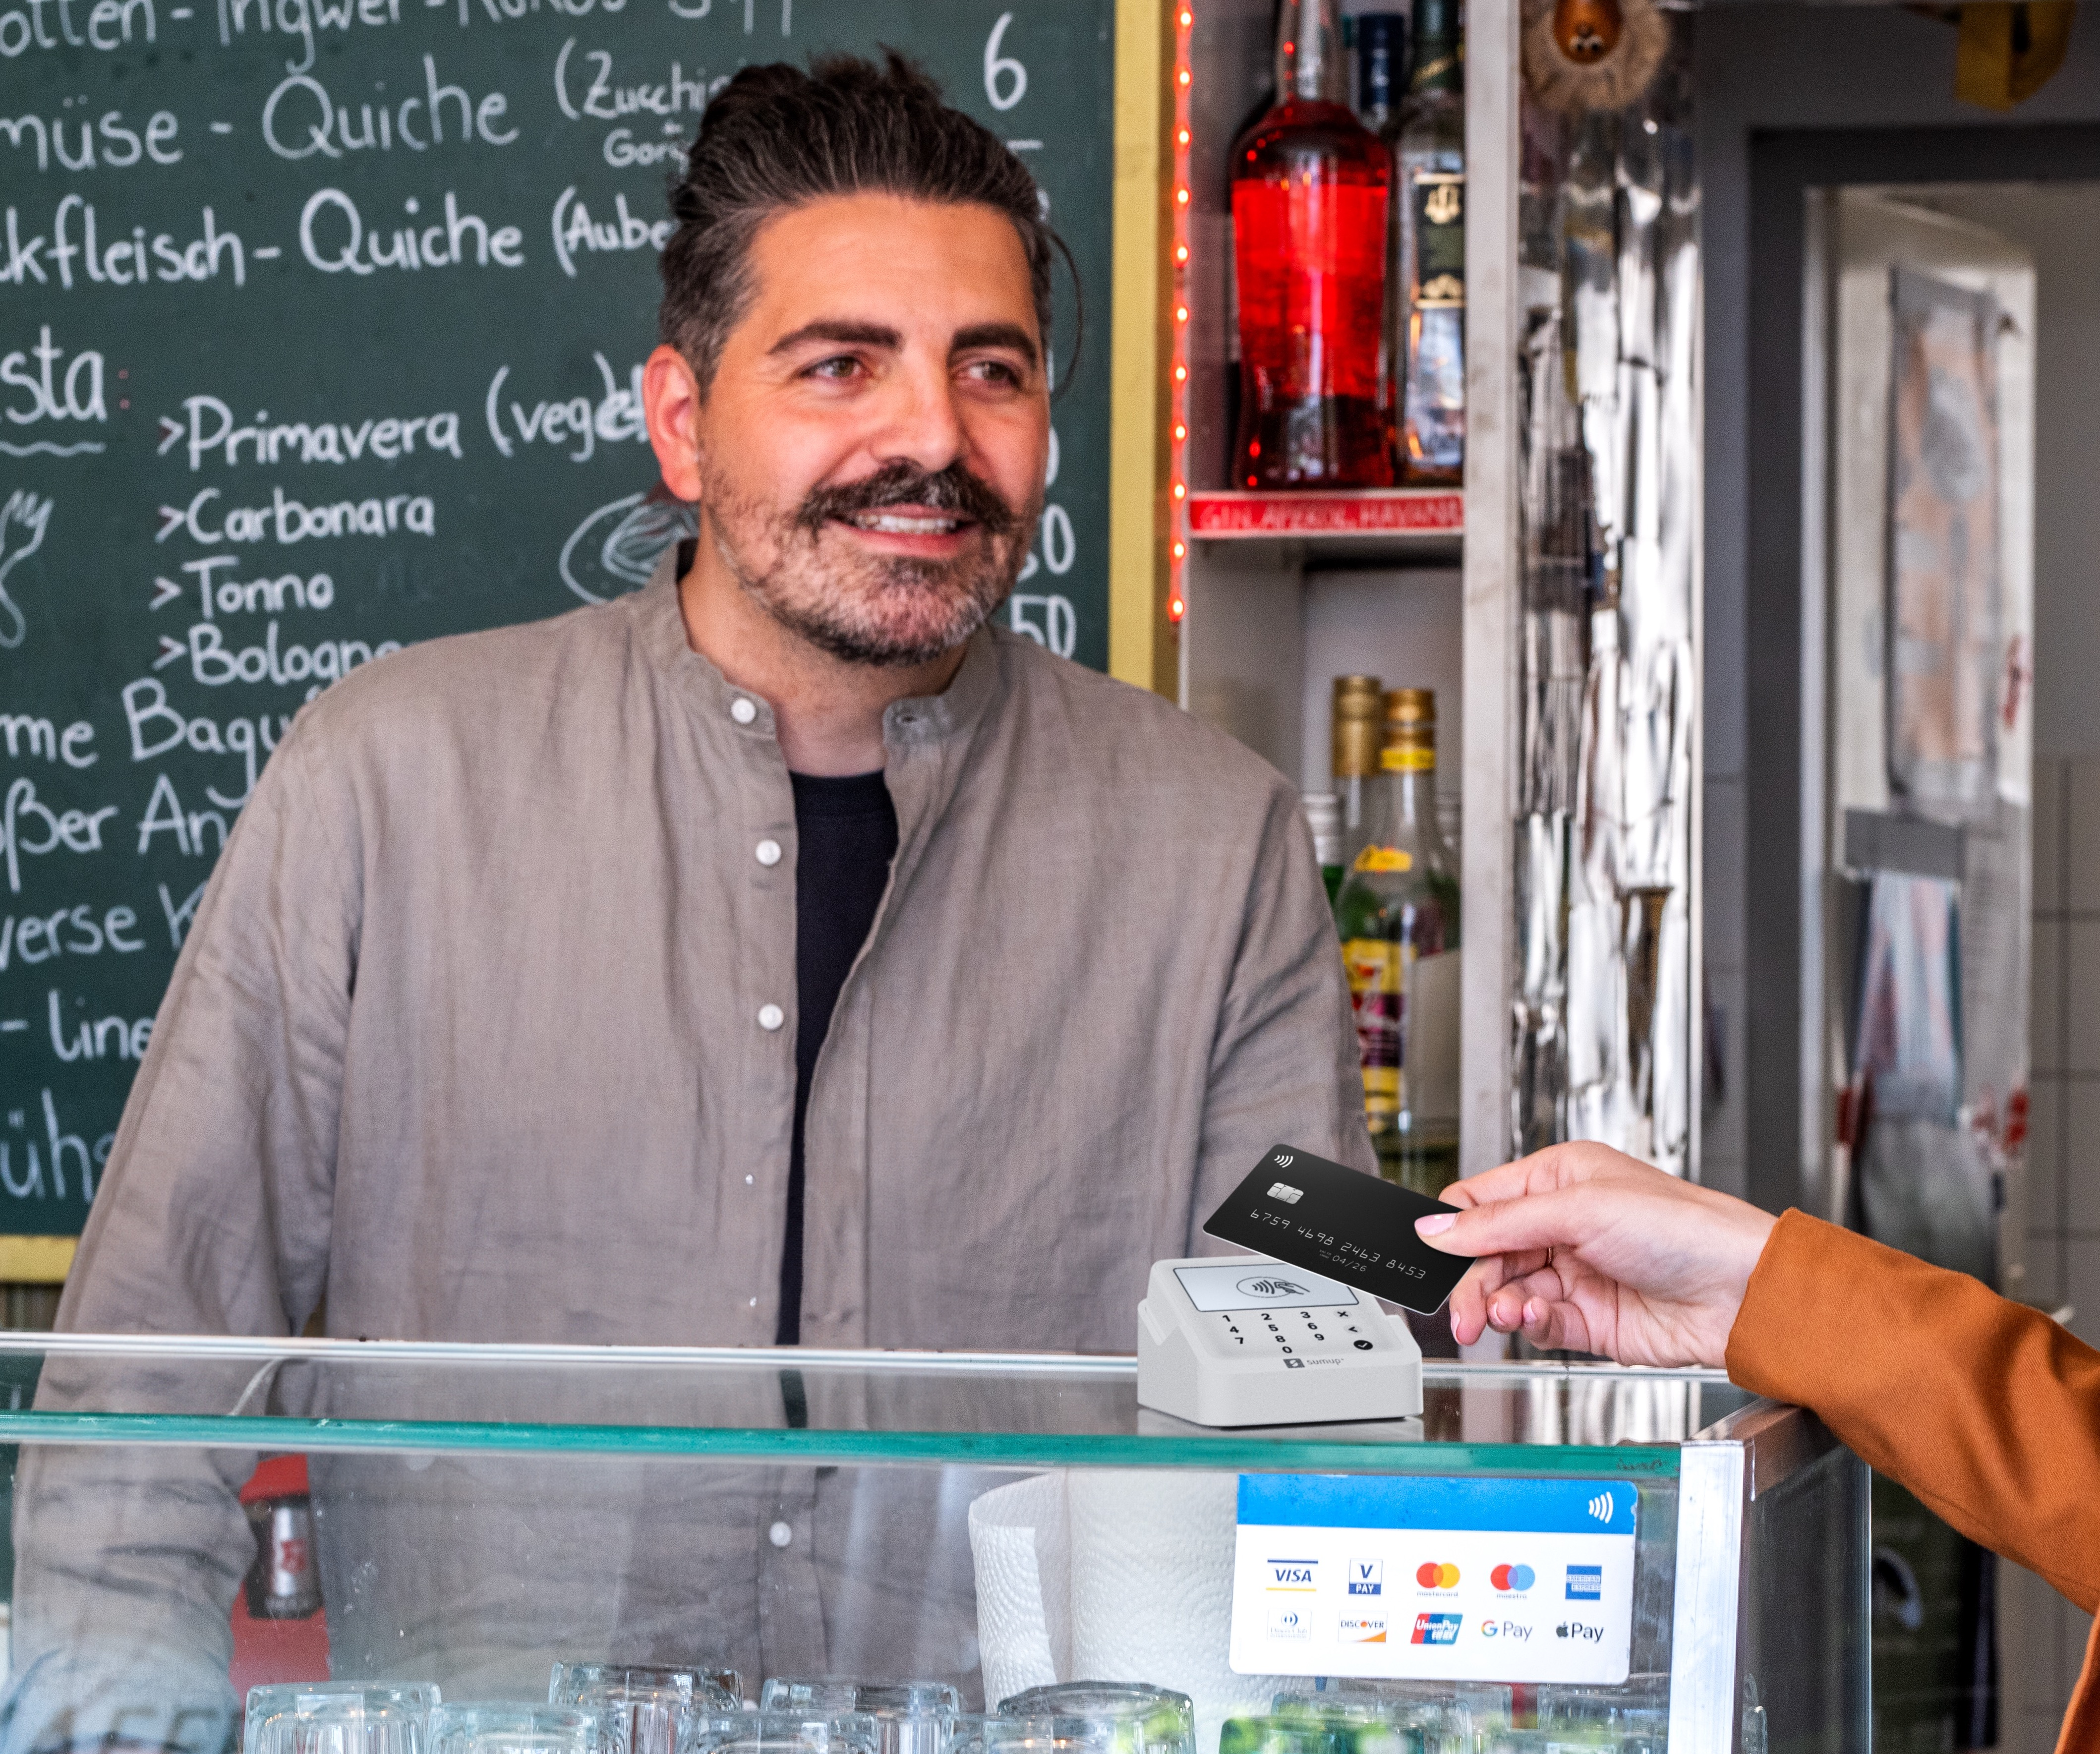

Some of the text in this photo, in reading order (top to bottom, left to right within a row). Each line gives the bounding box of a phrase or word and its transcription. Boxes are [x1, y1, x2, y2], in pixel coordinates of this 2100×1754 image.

[984, 11, 1028, 111] 6
[263, 53, 520, 160] Quiche
[0, 193, 282, 292] kfleisch-
[299, 187, 525, 277] Quiche
[1250, 1209, 1426, 1279] 6759 4698 2463 8453
[1332, 1255, 1367, 1272] 04/26
[1274, 1568, 1312, 1582] VISA
[1360, 1563, 1373, 1579] V
[1355, 1584, 1374, 1594] PAY
[1341, 1620, 1384, 1629] DISCOVER
[1416, 1619, 1459, 1634] UnionPay
[1503, 1620, 1533, 1642] Pay
[1572, 1622, 1604, 1643] Pay
